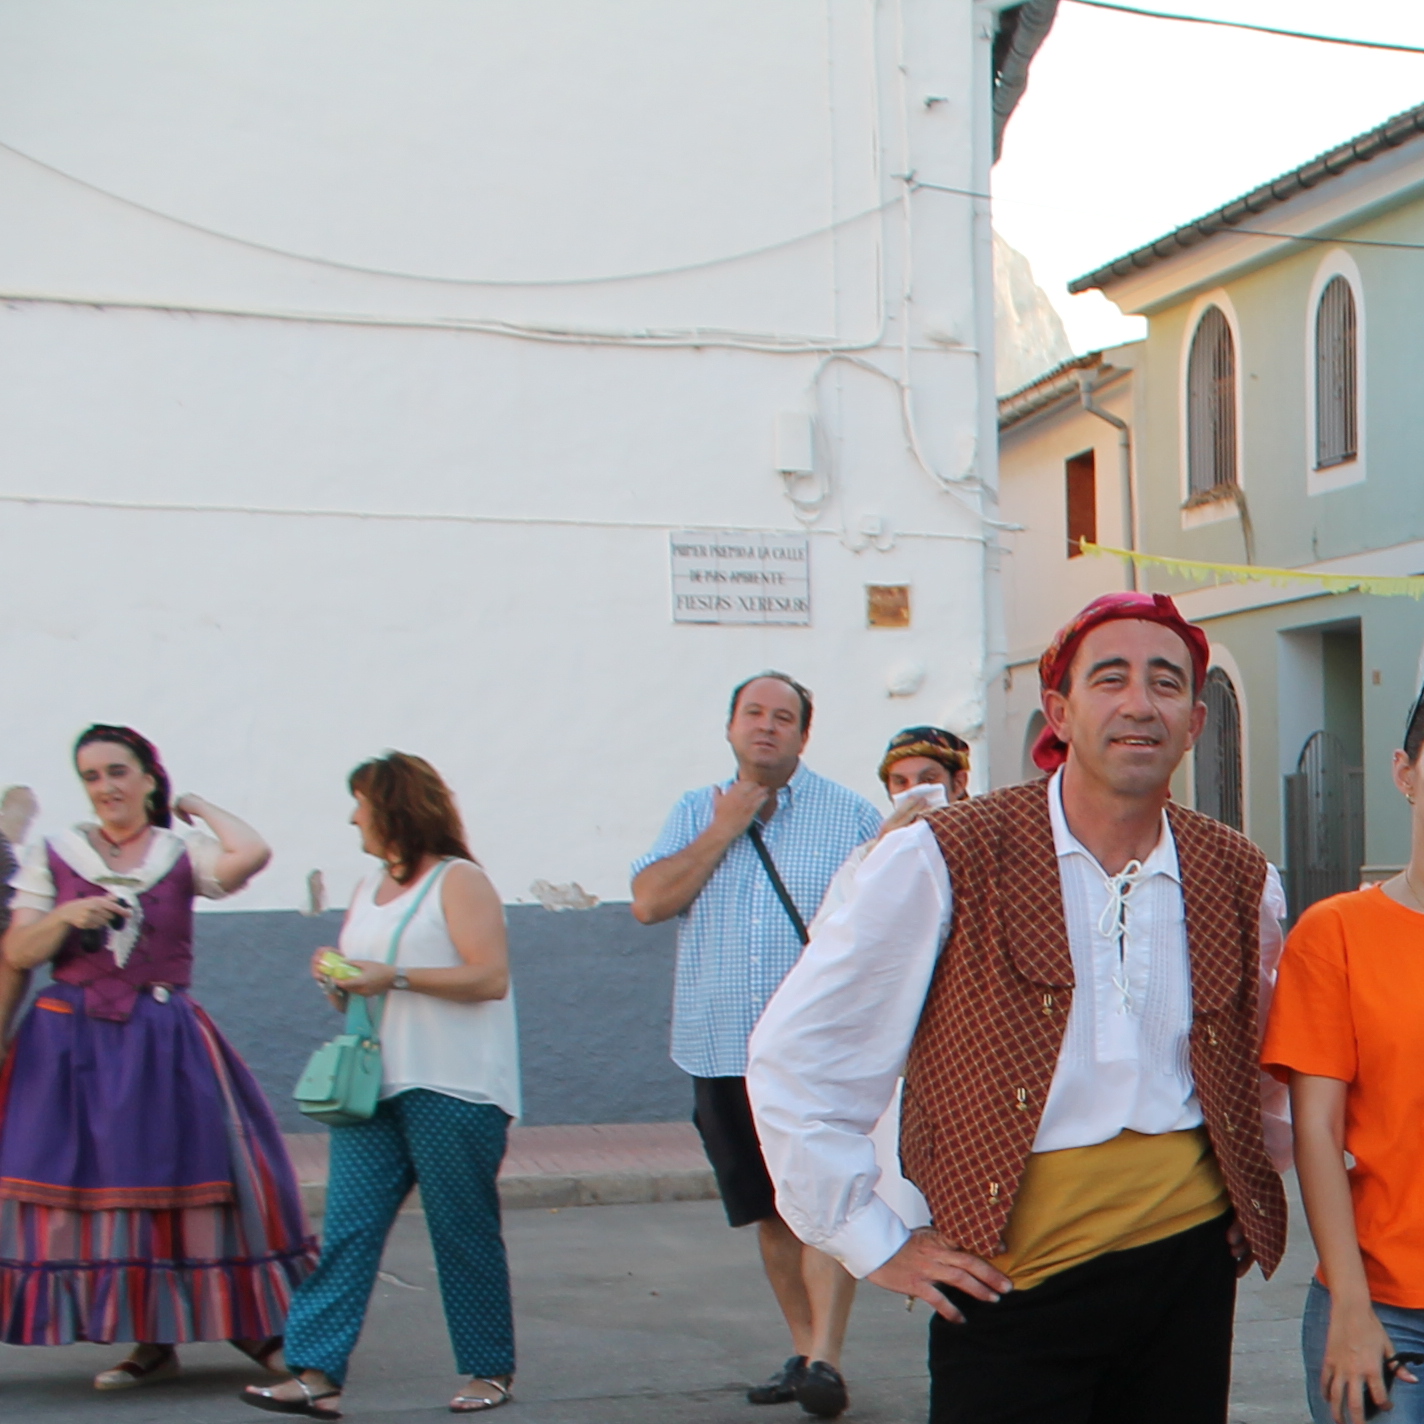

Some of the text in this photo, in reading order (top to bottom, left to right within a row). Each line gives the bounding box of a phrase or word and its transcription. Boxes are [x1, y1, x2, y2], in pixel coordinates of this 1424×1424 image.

[673, 544, 805, 561] PRIMER PREMIO A LA CALLE
[730, 570, 785, 585] AMBIENTE
[677, 594, 733, 611] FIESTAS
